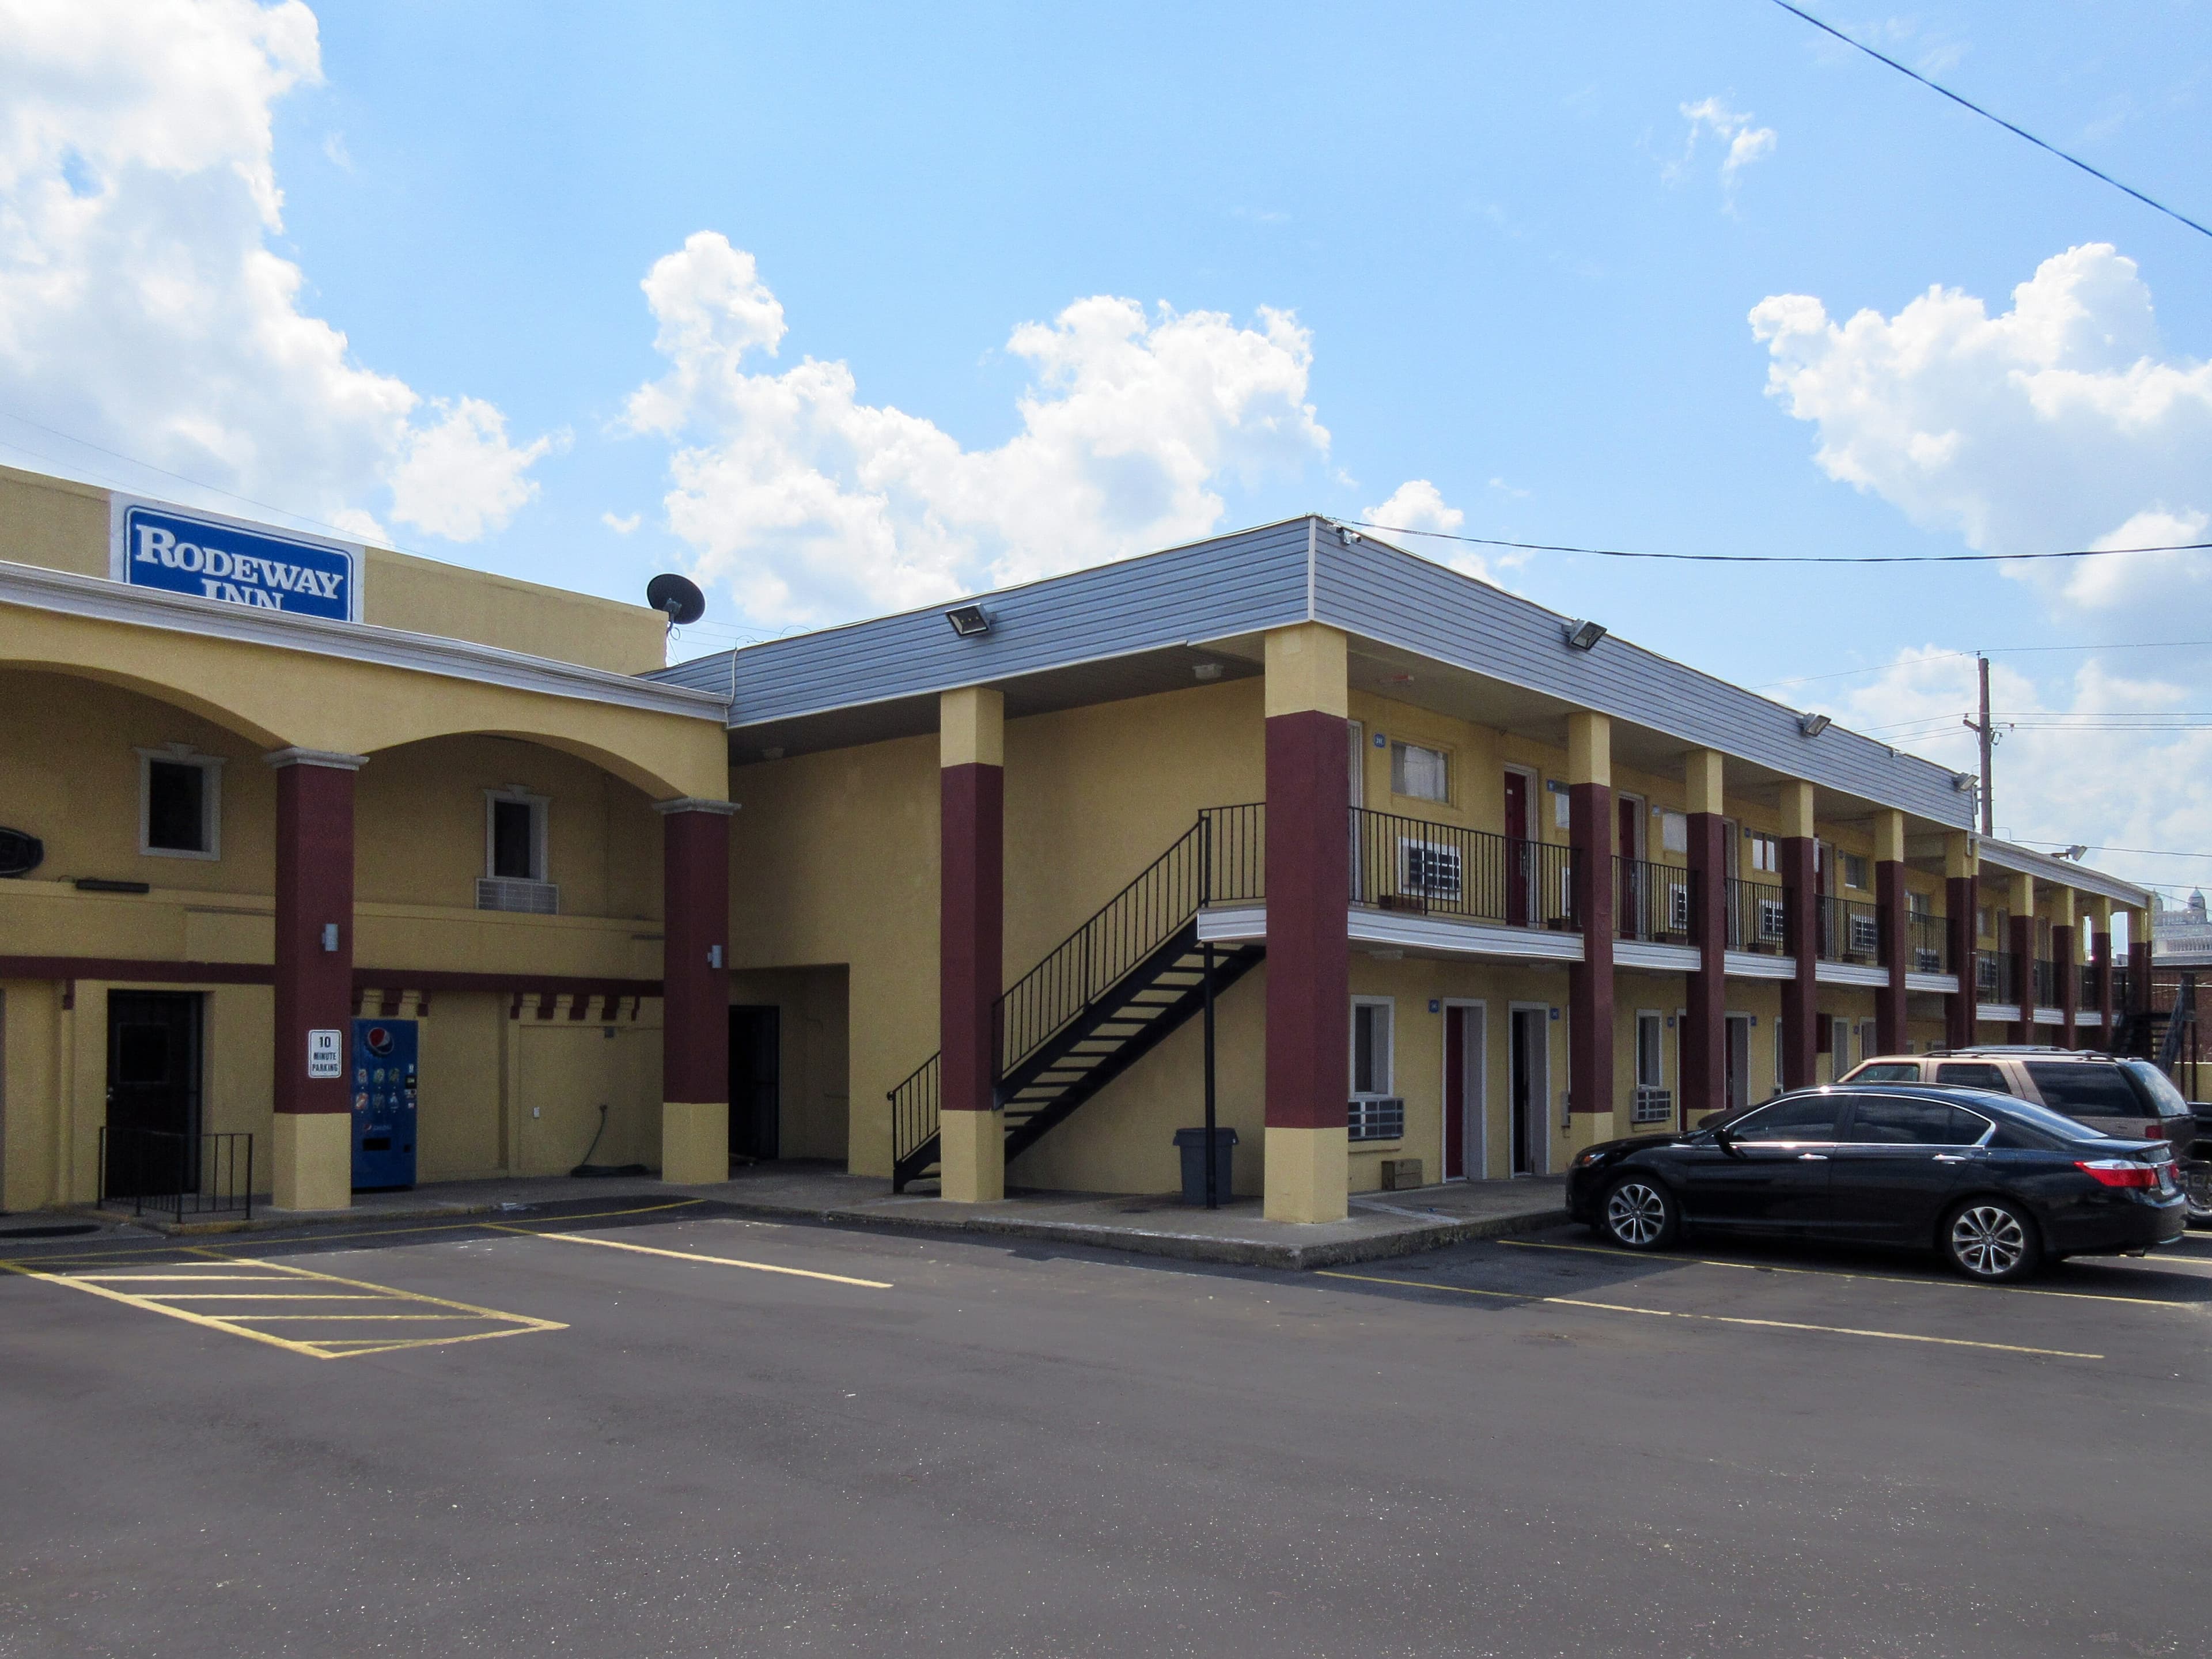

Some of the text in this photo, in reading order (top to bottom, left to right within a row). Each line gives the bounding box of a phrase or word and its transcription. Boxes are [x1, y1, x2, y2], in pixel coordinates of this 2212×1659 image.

[135, 524, 344, 600] RODEWAY
[202, 578, 285, 611] INN
[319, 1036, 331, 1048] 10
[313, 1052, 336, 1060] MINUTE
